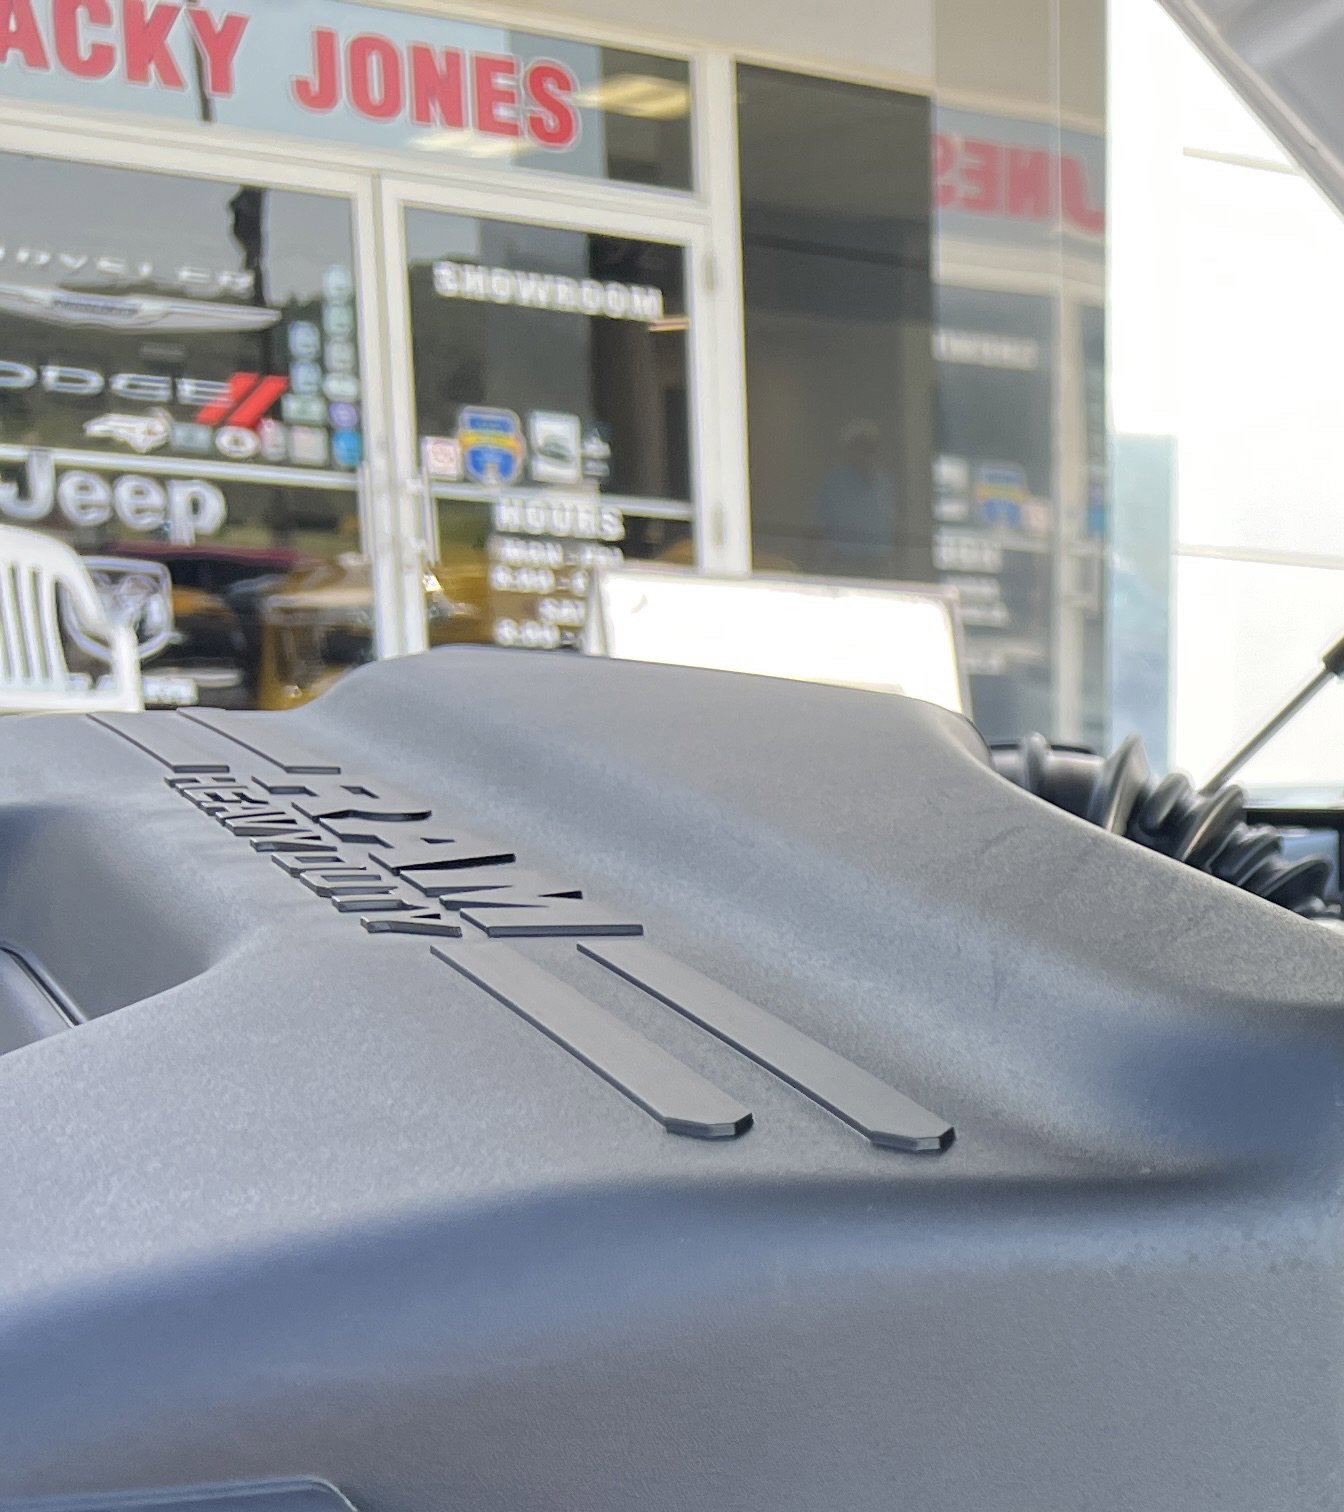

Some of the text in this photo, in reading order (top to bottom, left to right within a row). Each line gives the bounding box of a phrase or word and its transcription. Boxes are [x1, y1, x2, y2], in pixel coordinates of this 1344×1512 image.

[291, 26, 582, 151] JONES
[433, 259, 664, 323] SHOWROOM
[0, 452, 226, 543] Jeep
[494, 500, 626, 541] HOURS
[250, 774, 644, 938] RAM
